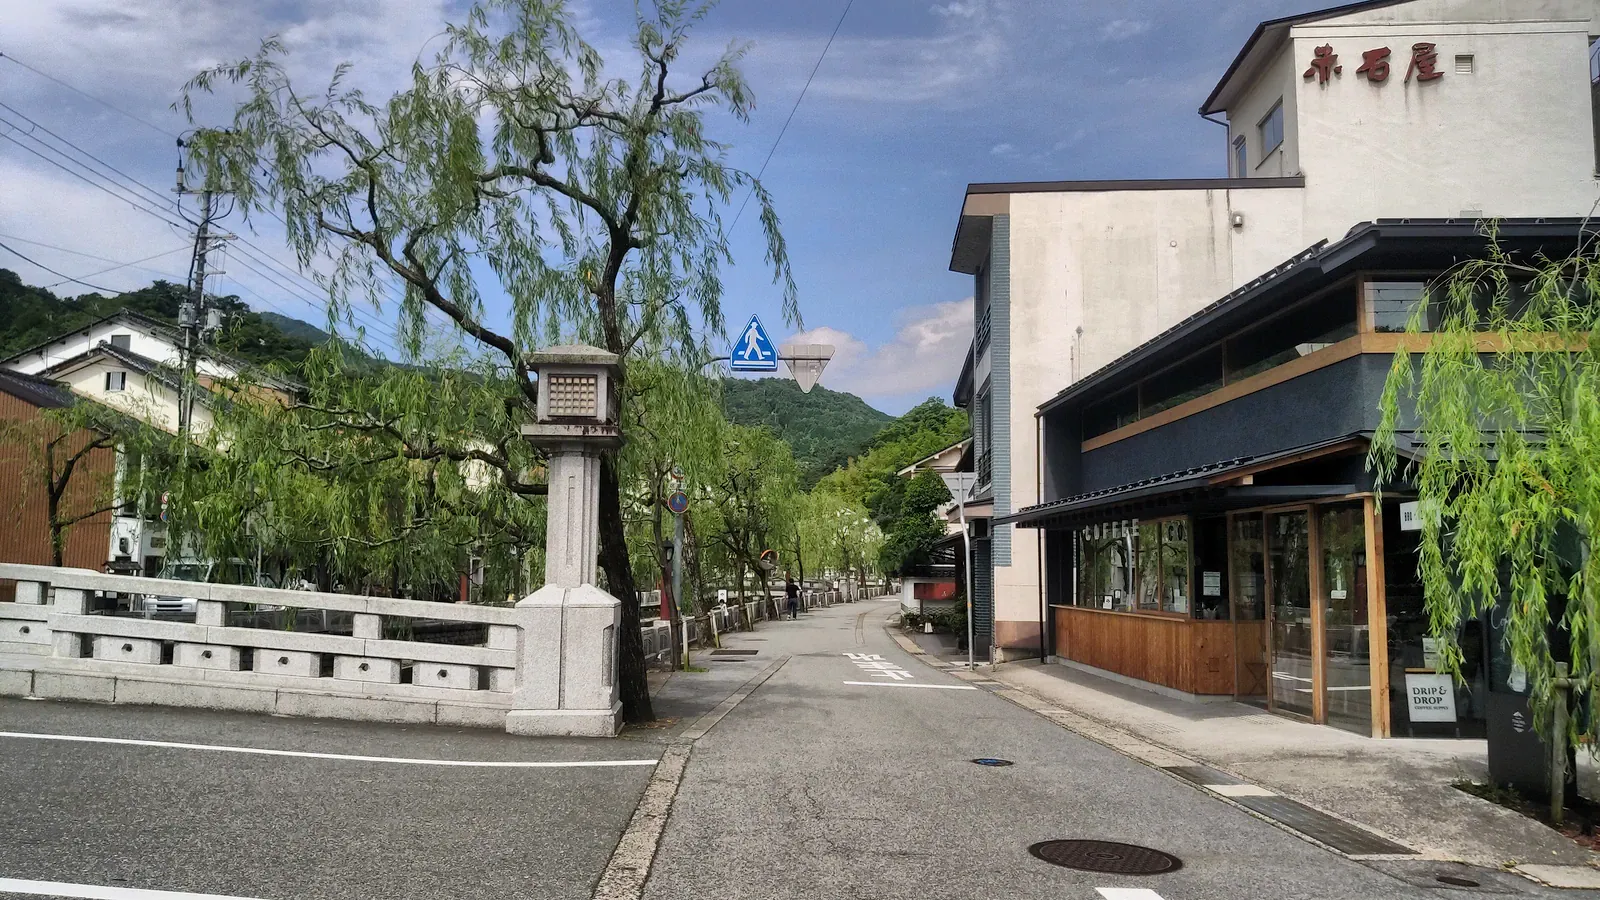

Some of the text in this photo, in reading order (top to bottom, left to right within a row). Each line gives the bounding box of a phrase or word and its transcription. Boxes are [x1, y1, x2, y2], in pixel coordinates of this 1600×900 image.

[1302, 42, 1445, 84] 赤石屋
[1085, 518, 1140, 541] COFFEE
[1412, 685, 1447, 695] DRIP &
[1413, 696, 1443, 705] DROP
